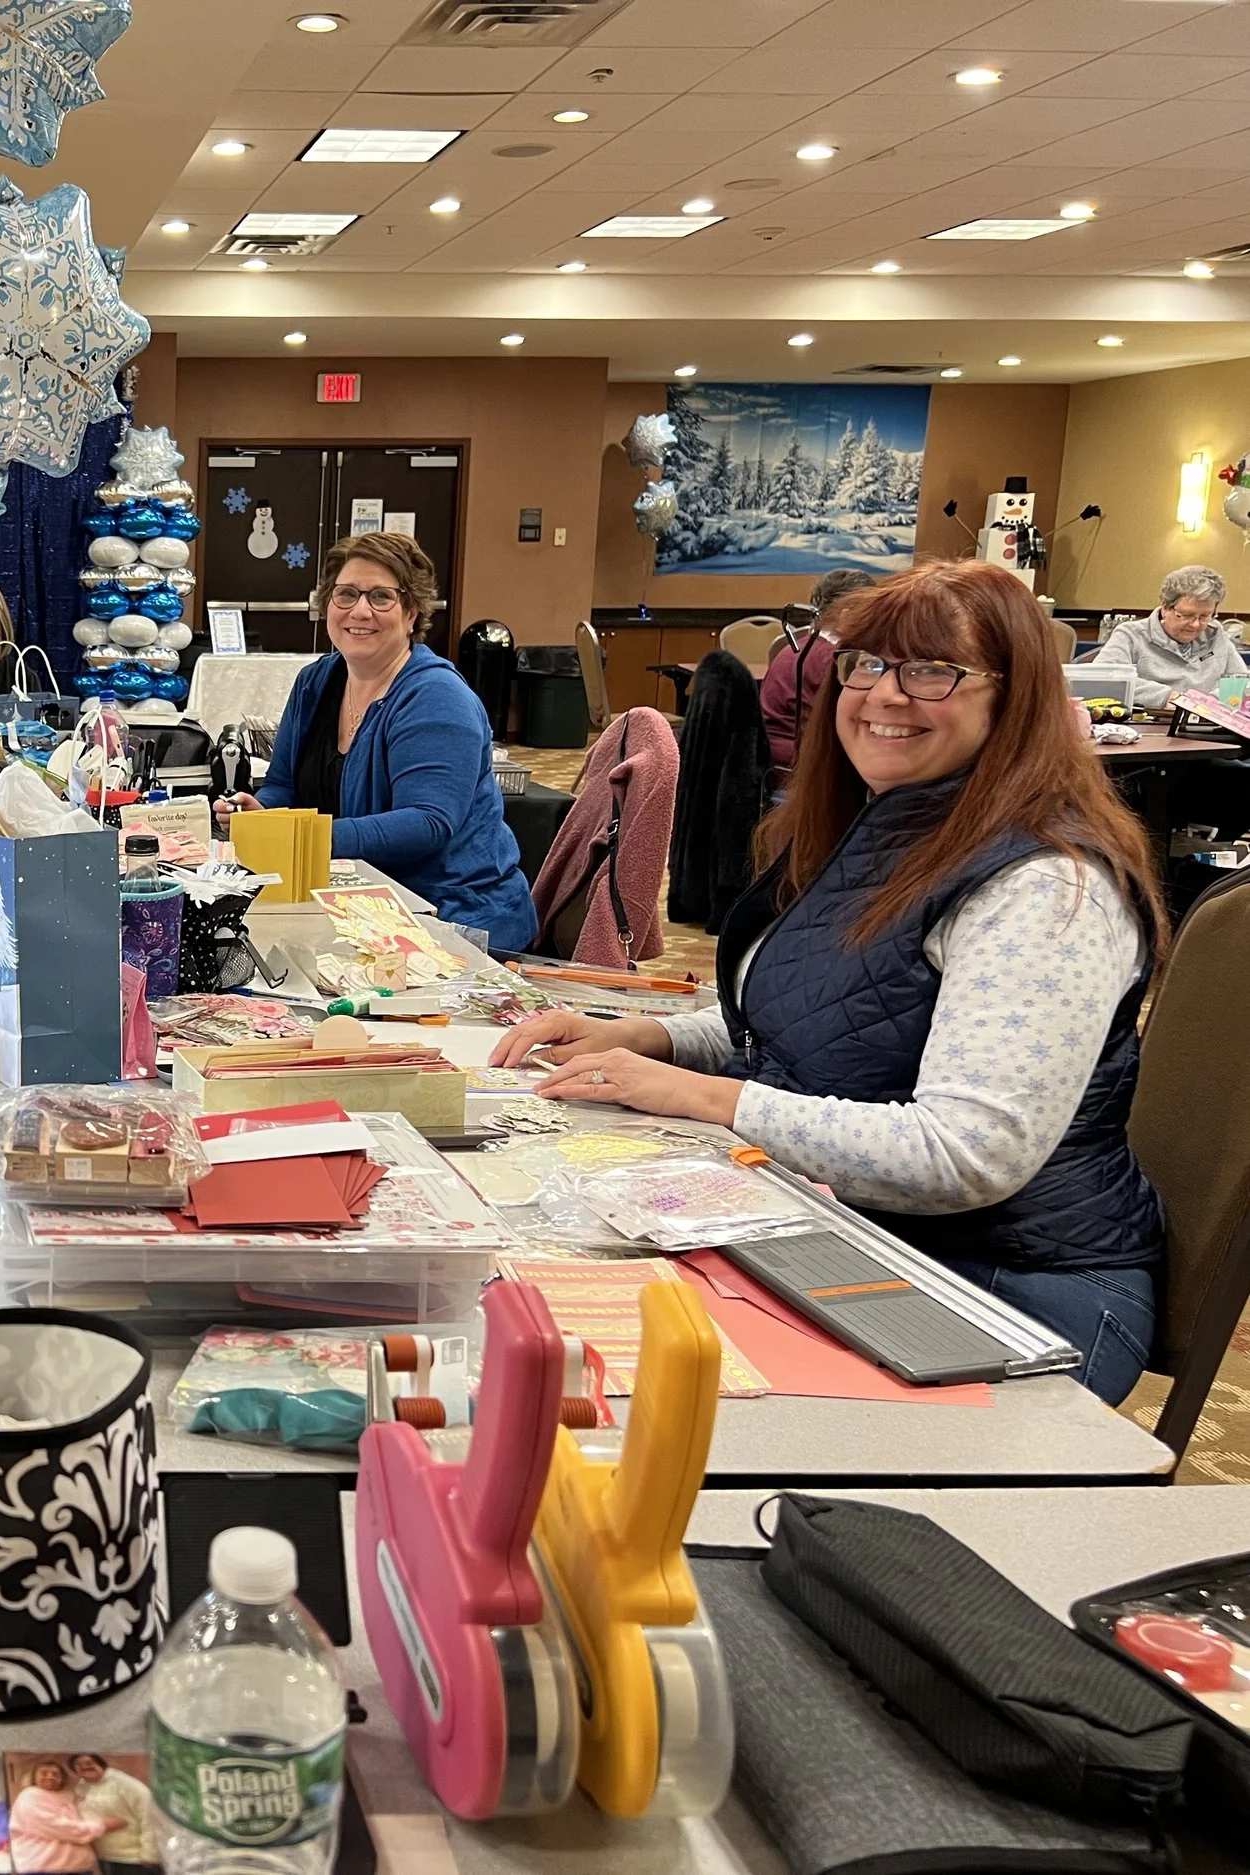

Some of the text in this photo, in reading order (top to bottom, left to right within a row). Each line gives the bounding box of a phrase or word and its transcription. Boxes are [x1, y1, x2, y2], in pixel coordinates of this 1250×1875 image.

[324, 375, 356, 400] EXIT
[197, 1760, 297, 1794] Poland
[202, 1790, 300, 1828] Spring
